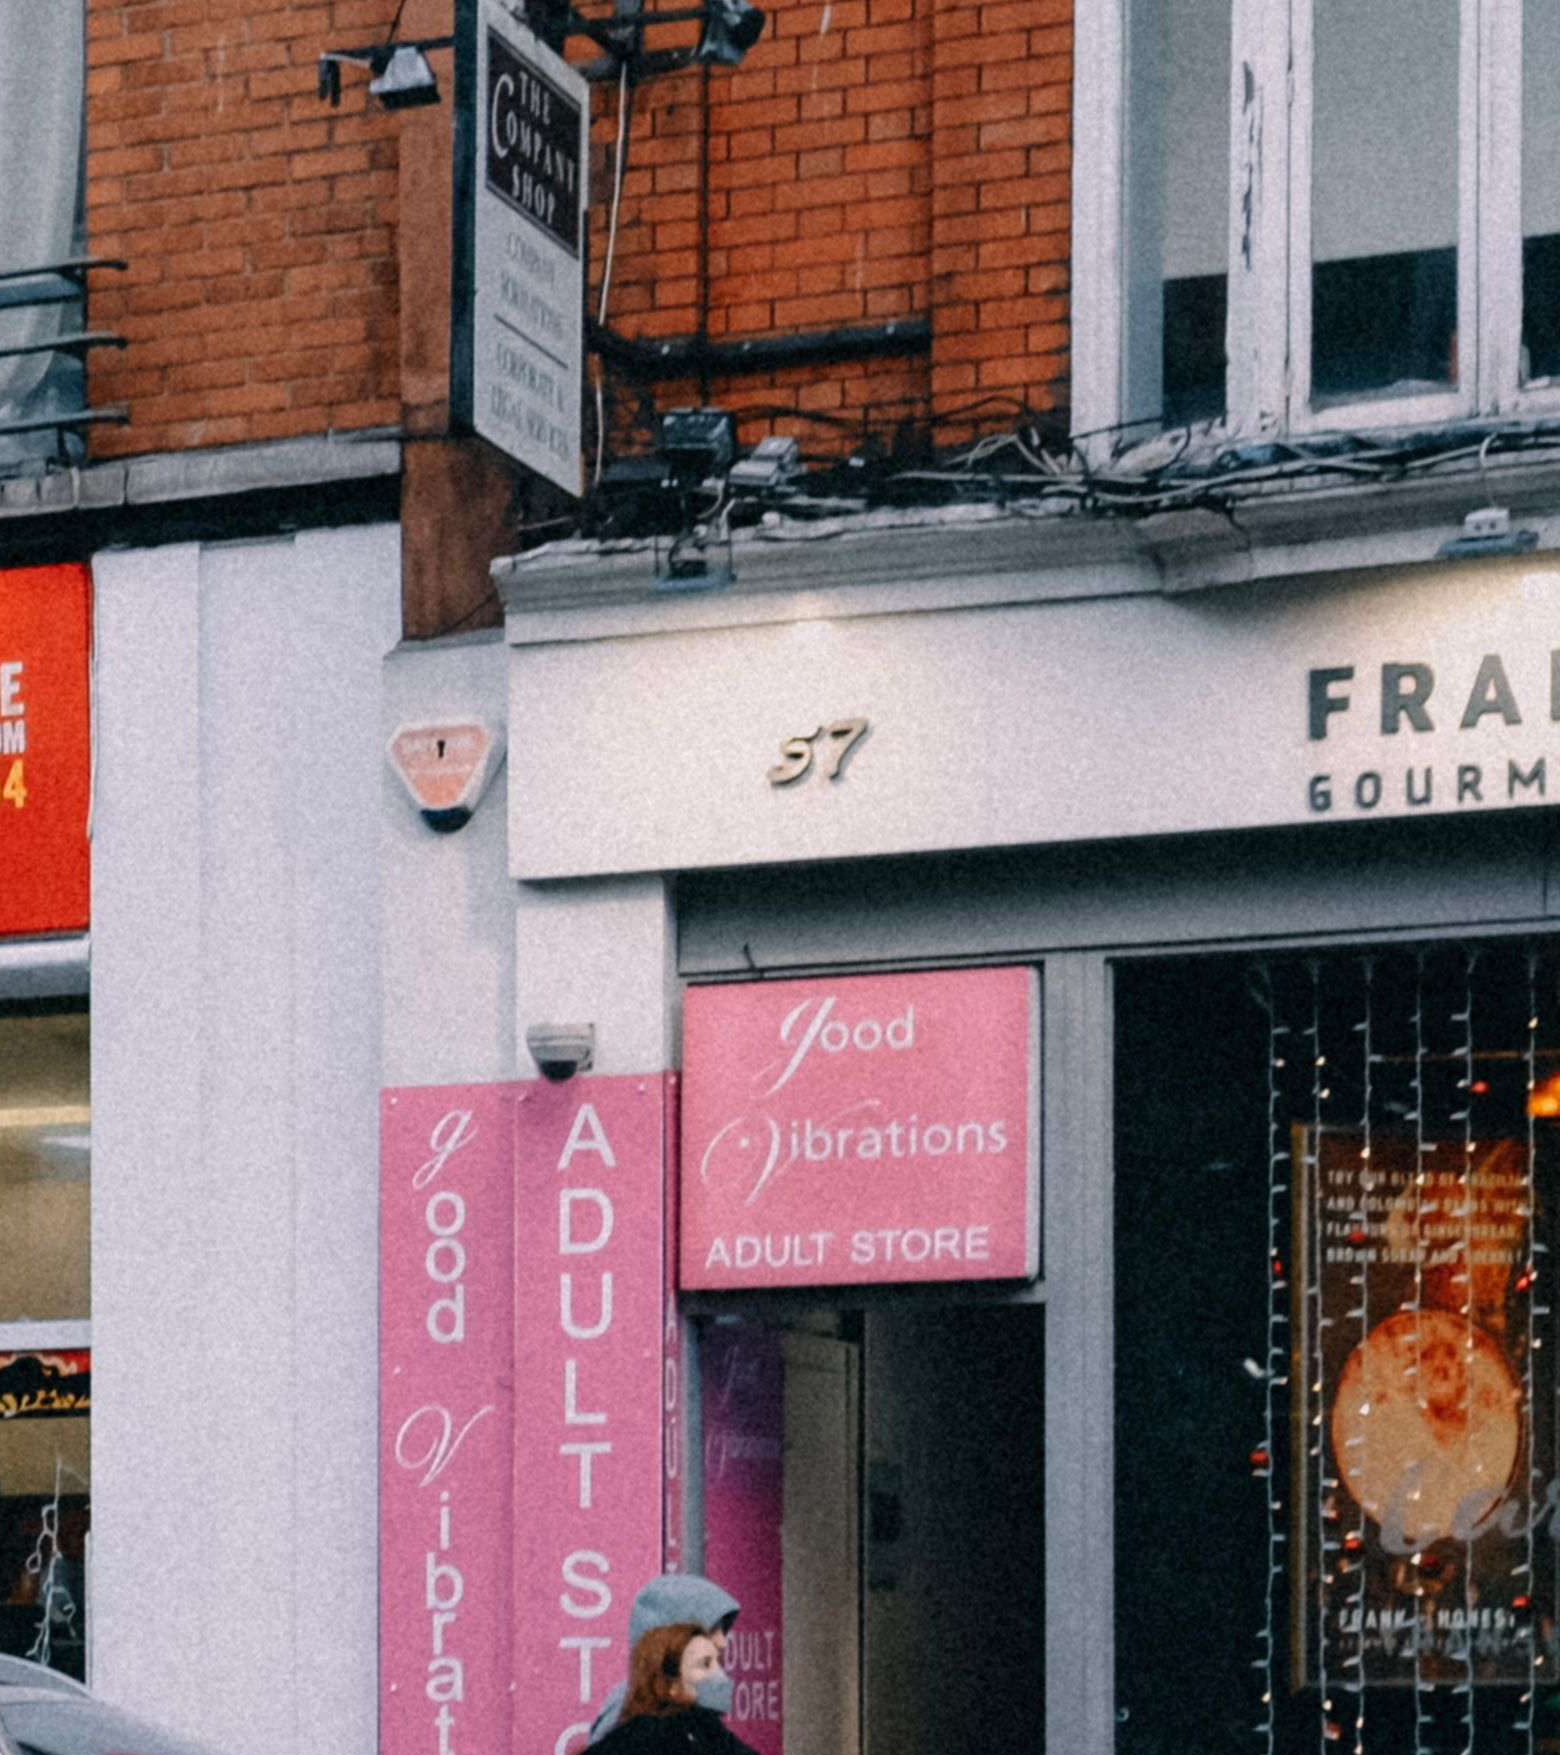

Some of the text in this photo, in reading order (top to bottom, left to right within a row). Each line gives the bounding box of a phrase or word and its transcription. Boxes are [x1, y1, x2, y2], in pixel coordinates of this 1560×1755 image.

[519, 71, 551, 125] THE
[512, 164, 556, 225] SHOP
[1308, 650, 1560, 740] FRA
[767, 717, 869, 786] 57
[1309, 758, 1545, 811] GOURM
[705, 1226, 989, 1269] ADULT STORE
[557, 1103, 616, 1509] ADULT
[724, 1631, 775, 1671] DULT
